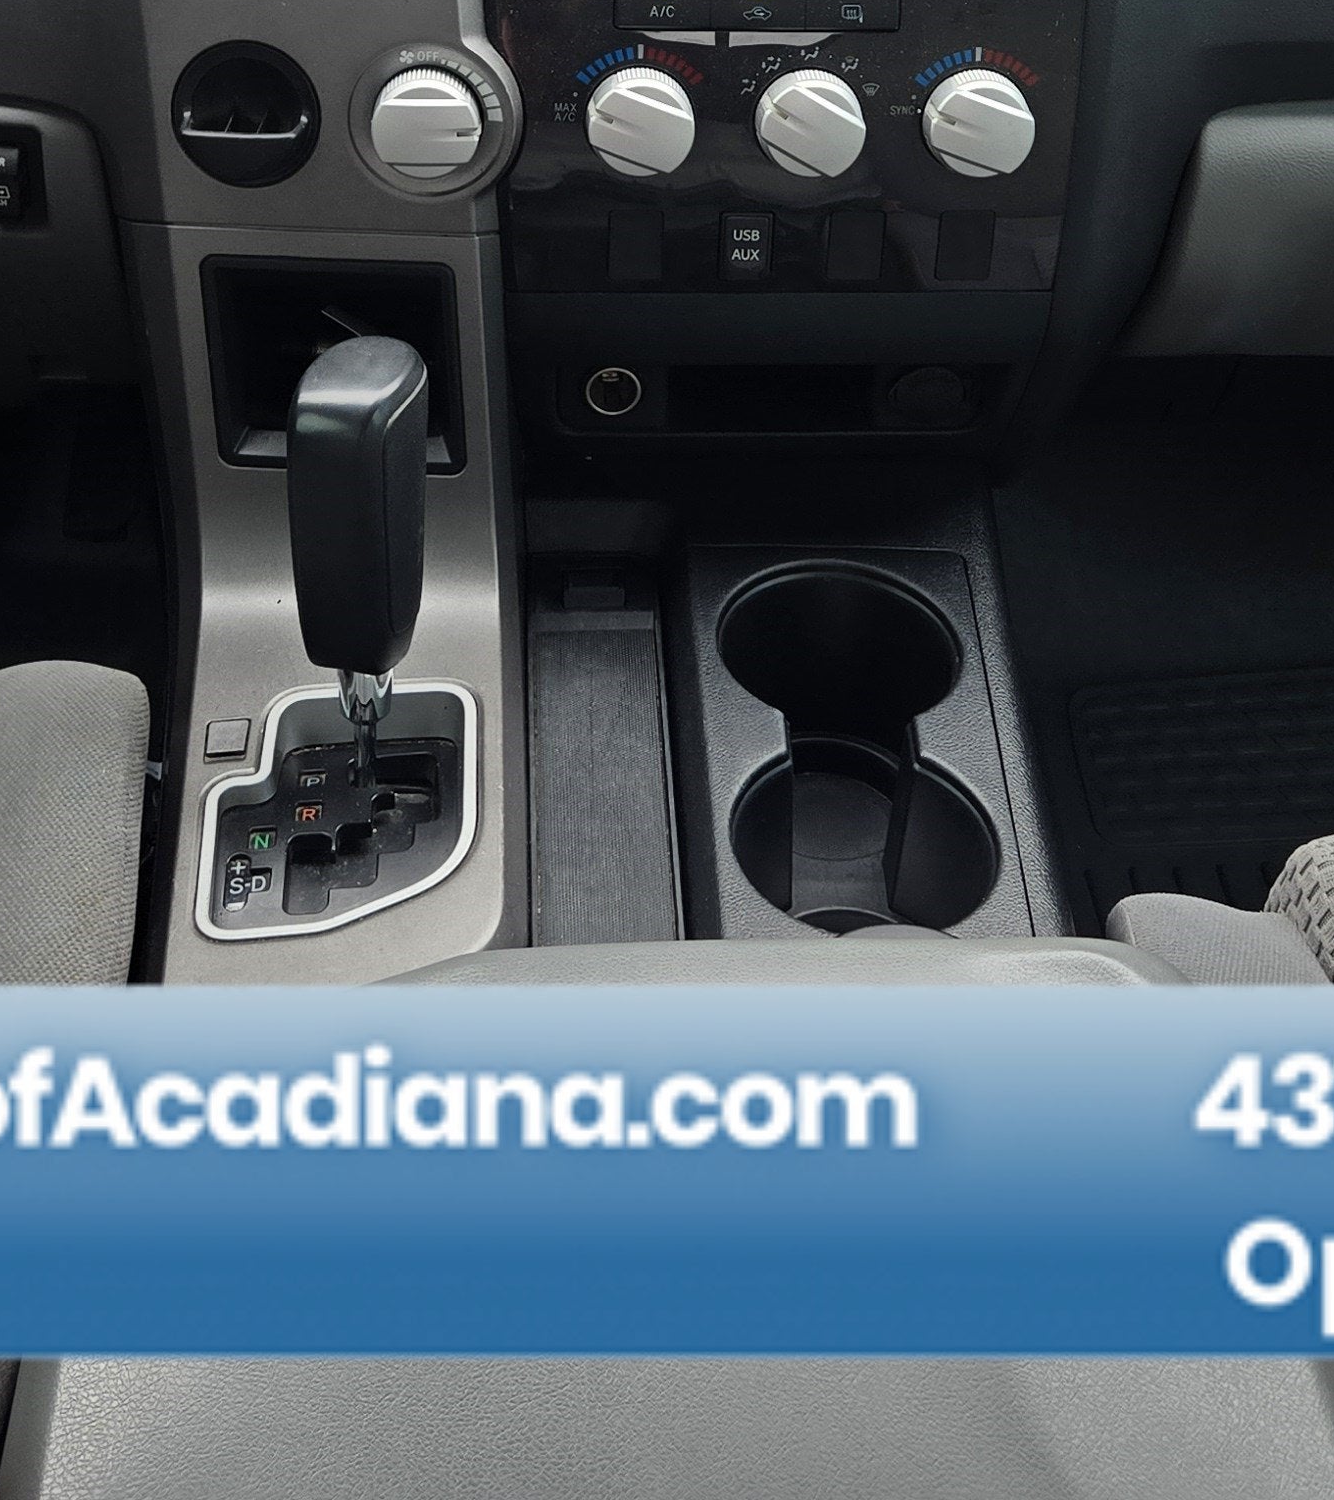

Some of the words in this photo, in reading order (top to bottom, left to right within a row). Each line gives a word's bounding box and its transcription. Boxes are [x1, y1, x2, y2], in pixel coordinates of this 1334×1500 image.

[649, 5, 675, 18] A/C
[417, 50, 440, 62] OFF
[554, 102, 578, 112] MAX
[889, 105, 915, 116] SYNC
[554, 112, 576, 122] A/C
[733, 229, 760, 241] USB
[731, 248, 760, 261] AUX
[306, 776, 320, 787] P
[301, 808, 316, 821] R
[254, 833, 271, 848] N
